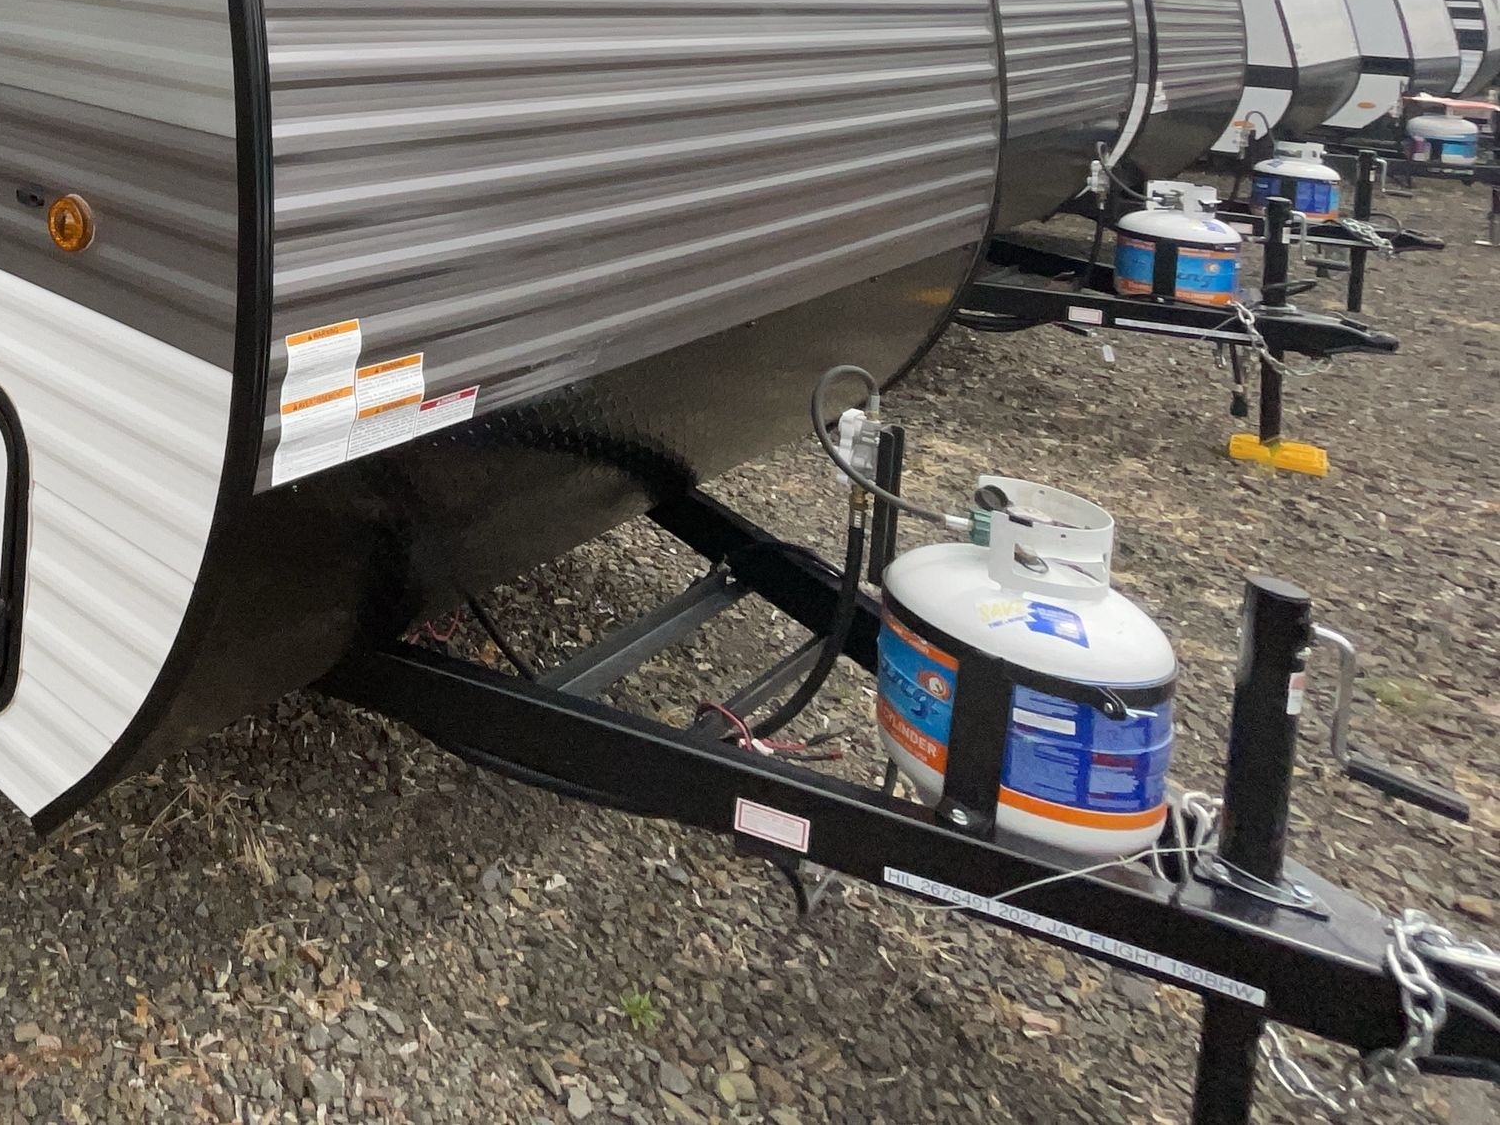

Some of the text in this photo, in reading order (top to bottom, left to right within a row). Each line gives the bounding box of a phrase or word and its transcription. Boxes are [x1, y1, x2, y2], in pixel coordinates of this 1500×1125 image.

[887, 869, 914, 888] HIL
[999, 906, 1042, 927] 2027
[1046, 922, 1084, 942] JAY
[1089, 937, 1162, 968] FLIGHT
[1171, 962, 1257, 1001] 130BHW
